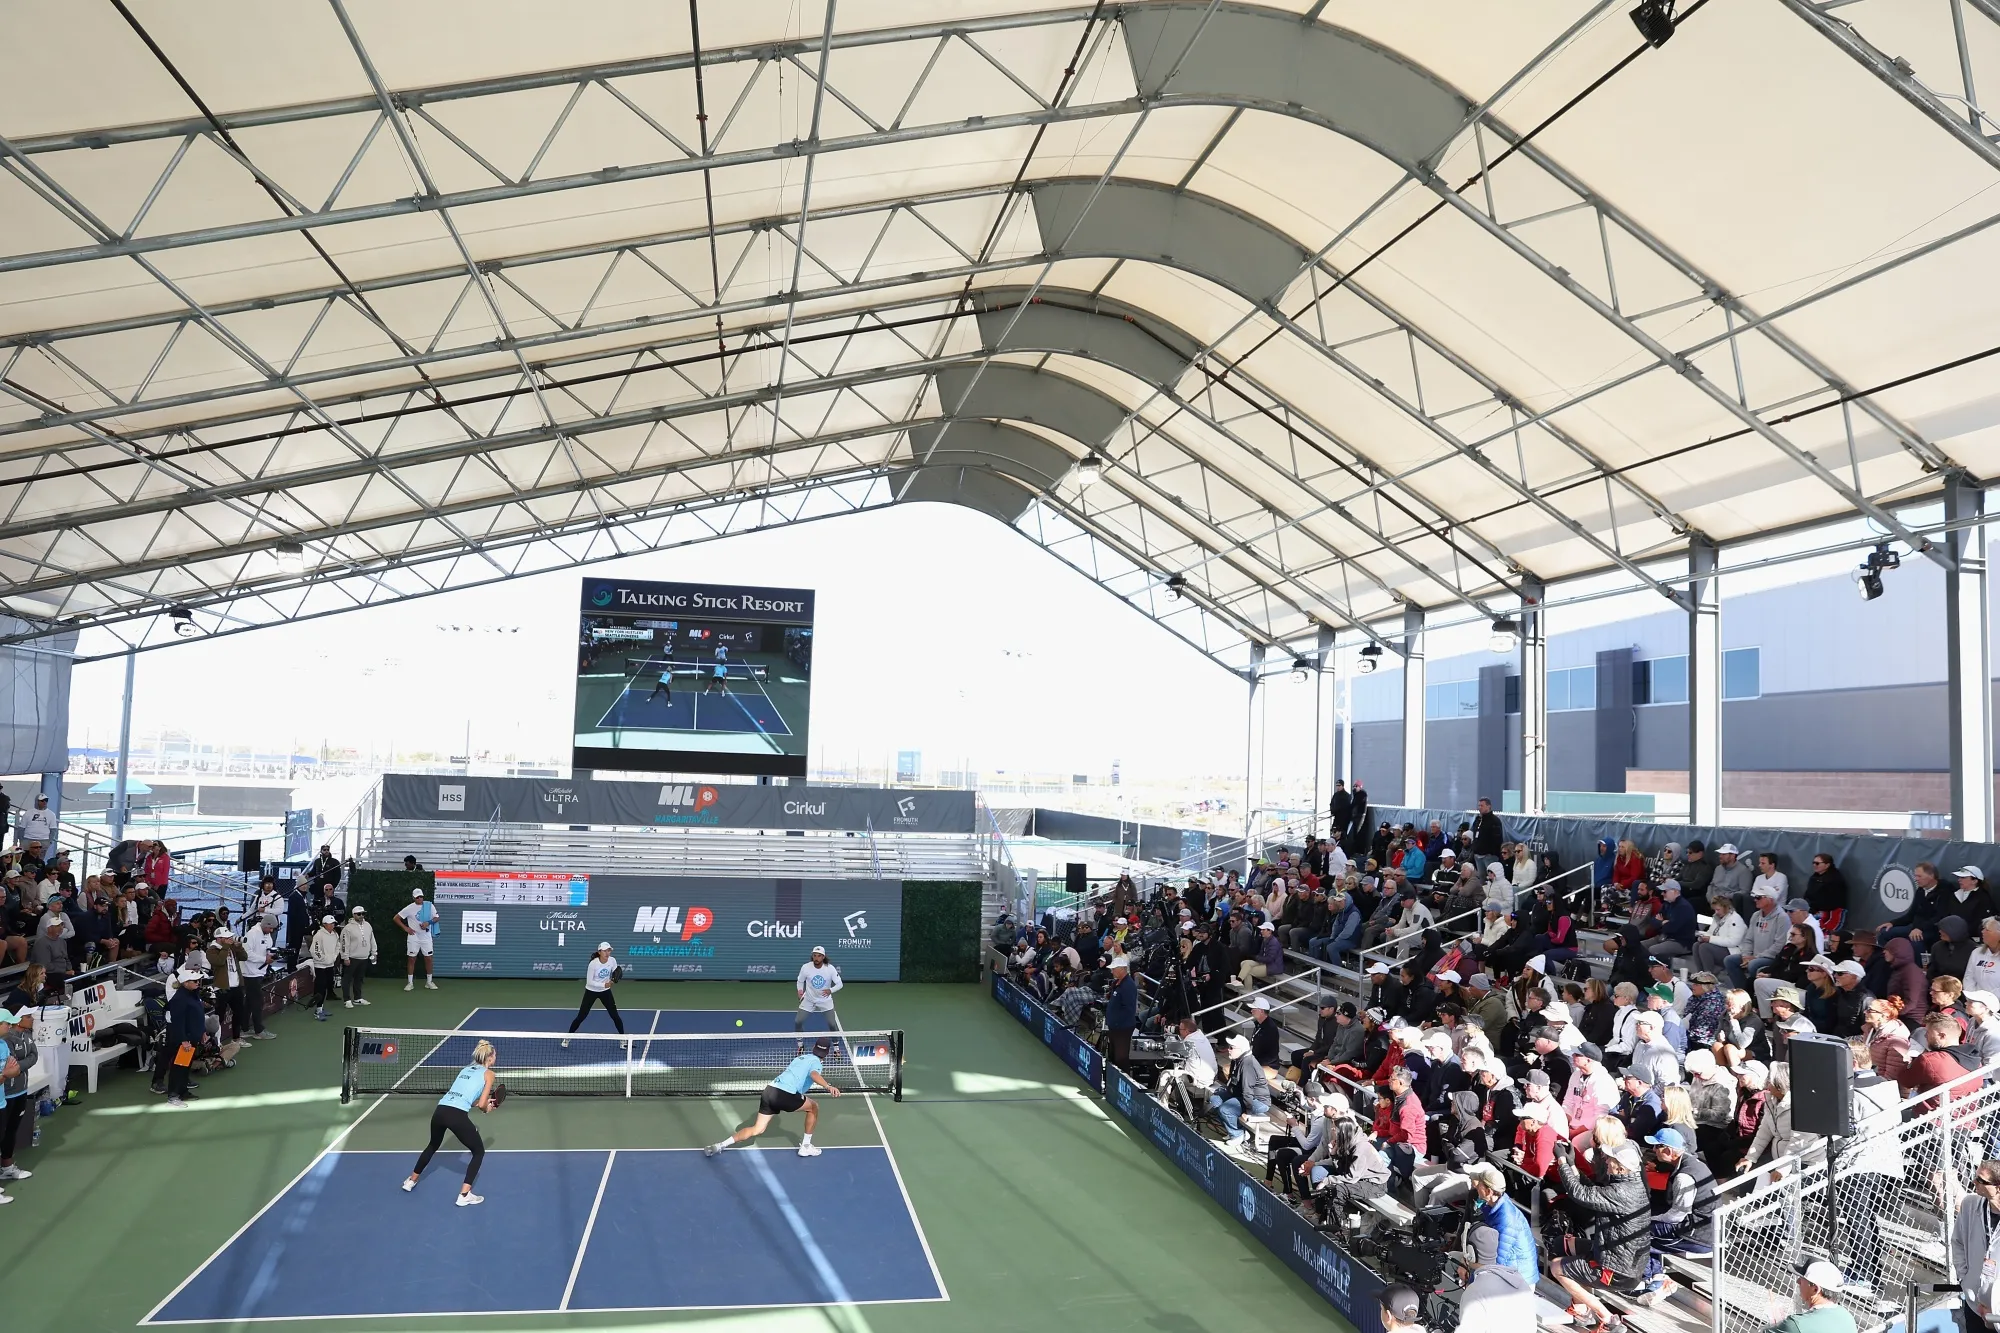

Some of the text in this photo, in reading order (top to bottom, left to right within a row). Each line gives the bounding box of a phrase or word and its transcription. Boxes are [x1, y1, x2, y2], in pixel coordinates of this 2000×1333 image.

[617, 588, 805, 613] TALKING STICK RESORT
[442, 793, 462, 802] HSS
[544, 794, 579, 803] ULTRA
[658, 785, 719, 813] MLP
[784, 801, 825, 815] Cirkul
[654, 814, 719, 825] MARGARITAVILLE
[1884, 882, 1909, 900] Ora
[466, 922, 493, 933] HSS
[540, 920, 586, 931] ULTRA
[633, 906, 714, 941] MLP
[746, 920, 802, 938] Cirkul
[653, 935, 661, 944] by
[628, 945, 715, 957] MARGARITAVILLE
[461, 962, 492, 970] MESA
[532, 962, 563, 971] MESA
[672, 964, 702, 972] MESA
[746, 965, 777, 973] MESA
[83, 984, 106, 1005] MLP
[68, 1013, 95, 1038] MLP
[70, 1040, 90, 1052] kul
[361, 1042, 397, 1060] MLP
